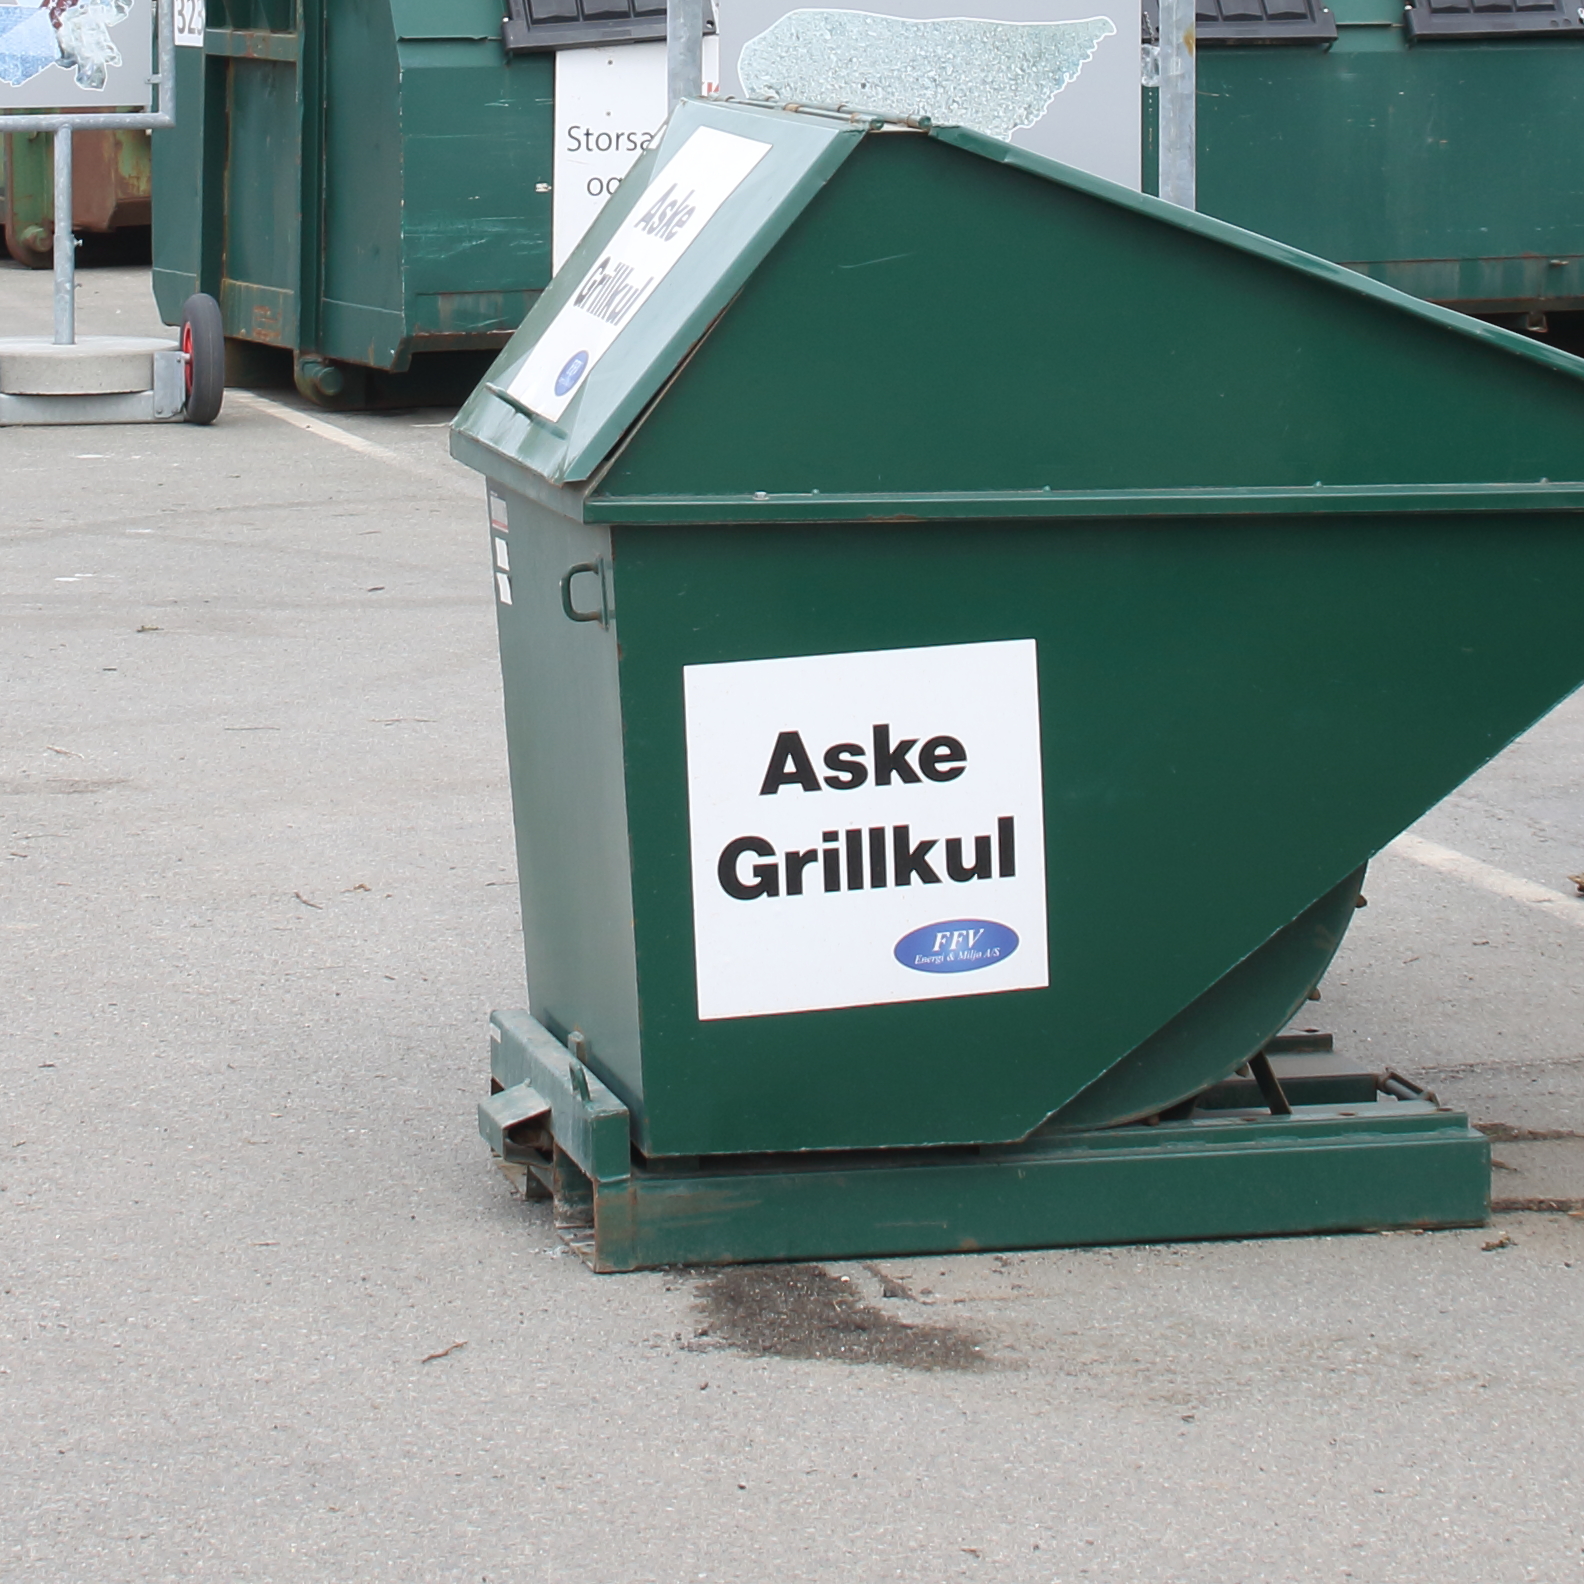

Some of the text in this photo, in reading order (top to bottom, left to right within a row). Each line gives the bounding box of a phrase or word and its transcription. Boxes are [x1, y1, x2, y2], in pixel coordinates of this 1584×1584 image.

[633, 182, 697, 243] Aske
[573, 256, 655, 327] Grillkul
[759, 722, 969, 797] Aske
[717, 814, 1017, 902] Grillkul
[914, 952, 944, 965] Energi
[946, 952, 955, 962] &
[983, 947, 1001, 959] A/S
[932, 928, 985, 952] FFV
